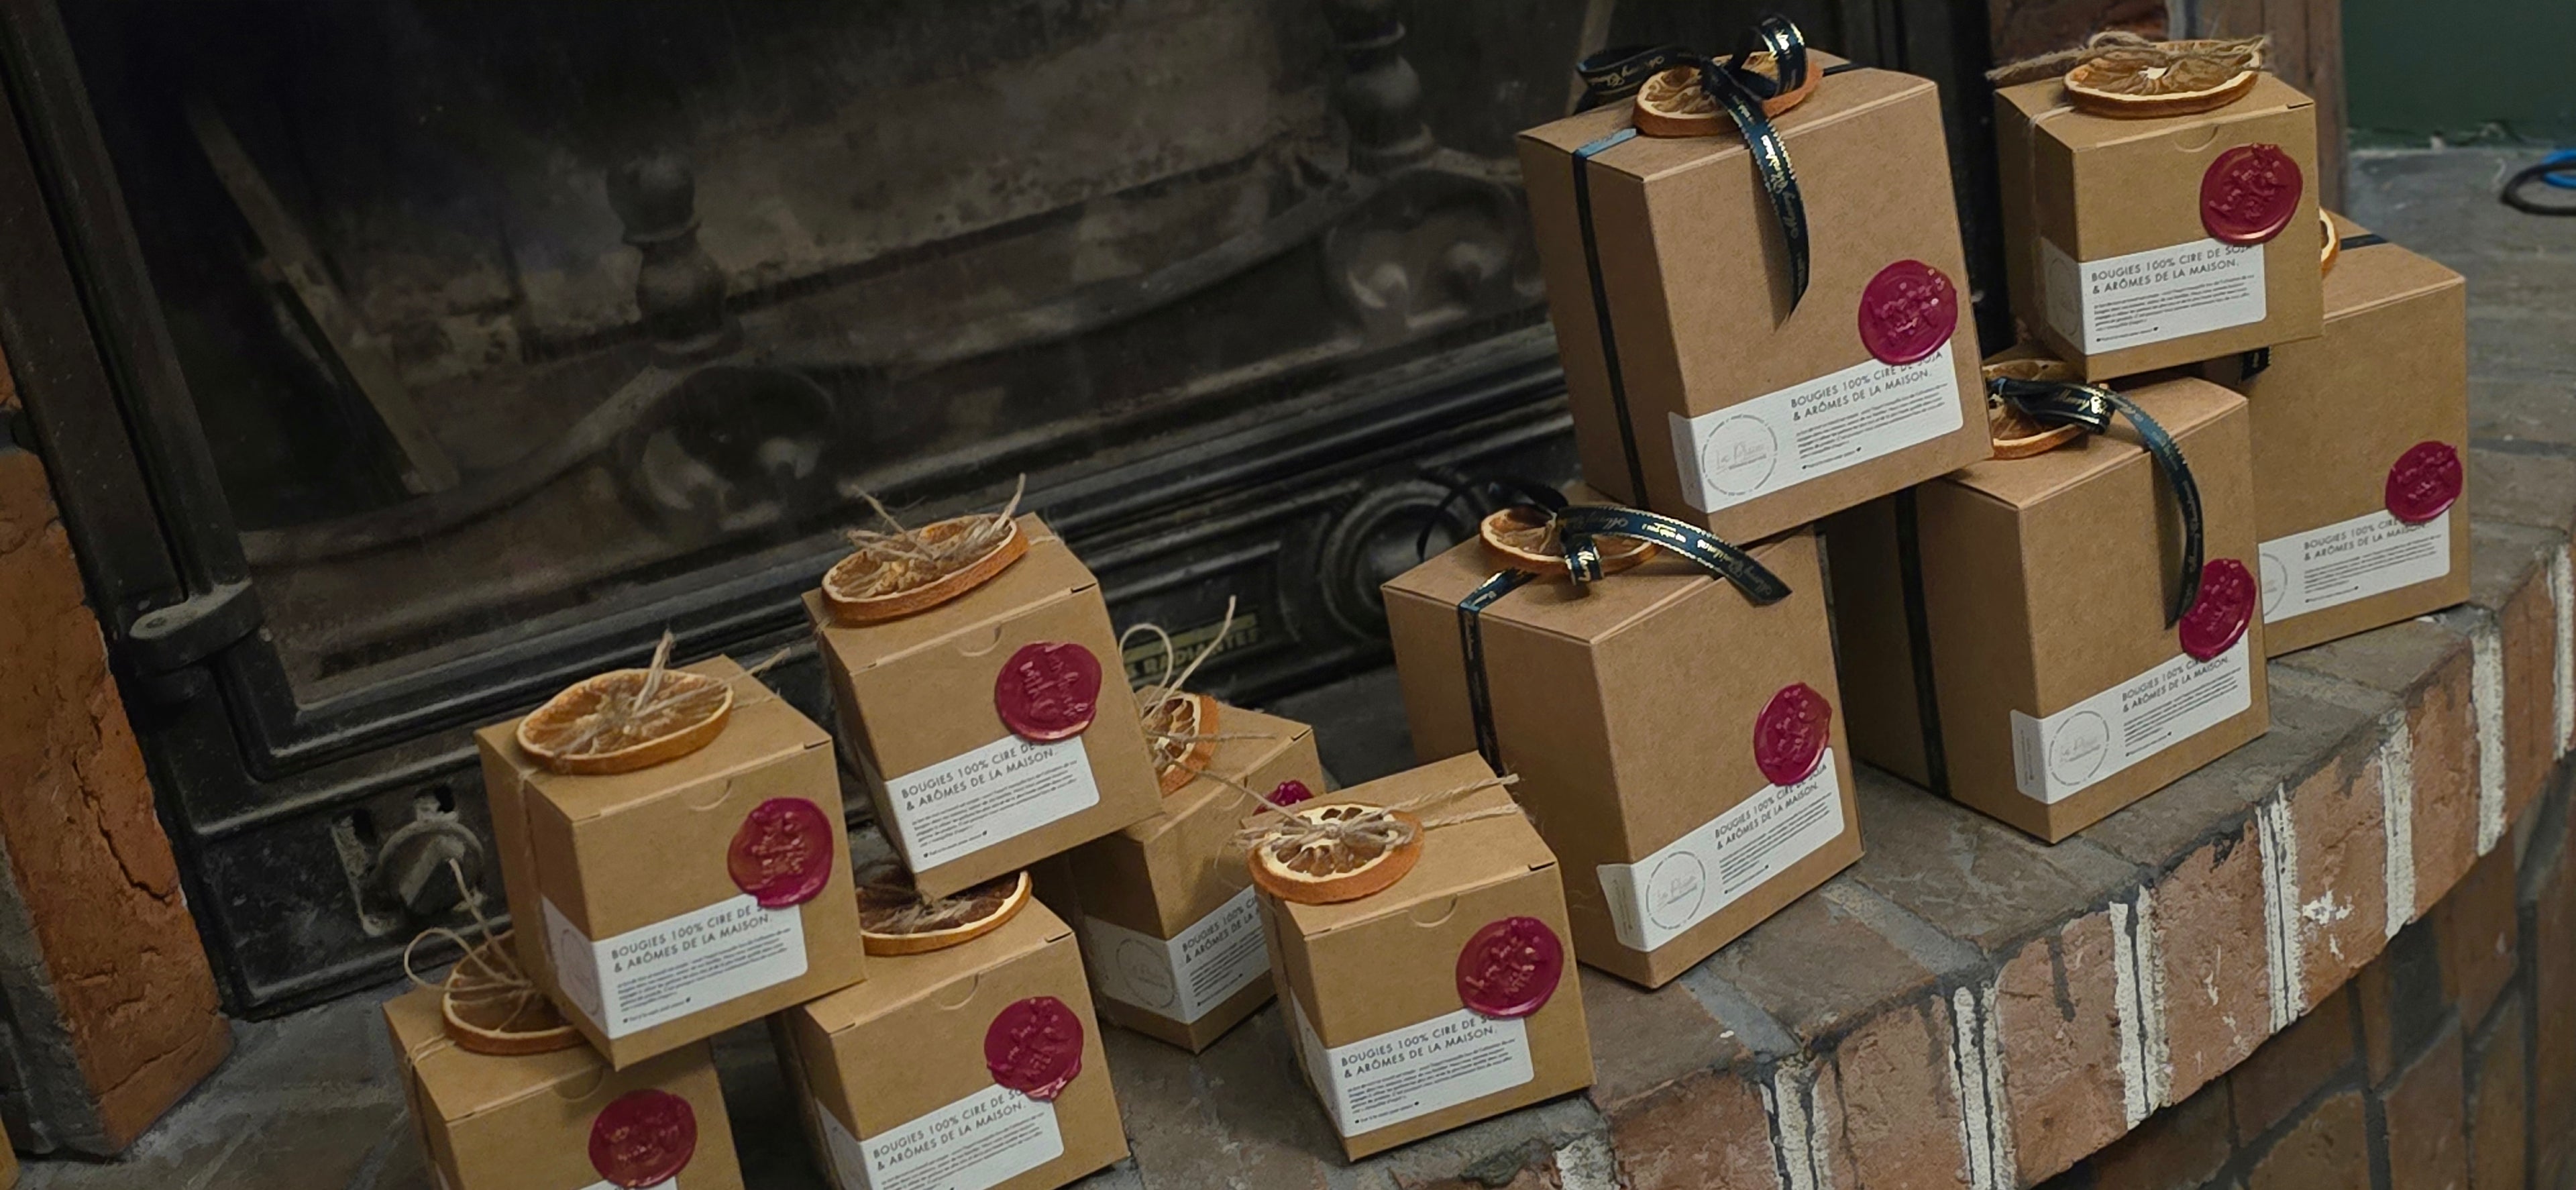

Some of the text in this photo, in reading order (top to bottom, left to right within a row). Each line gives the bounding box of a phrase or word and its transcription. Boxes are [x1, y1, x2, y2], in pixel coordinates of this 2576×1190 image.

[2092, 264, 2141, 282] BOUGIES
[2147, 258, 2176, 272] 100%
[2180, 251, 2202, 266] CIRE
[2207, 248, 2220, 259] DE
[2092, 285, 2100, 294] &
[2155, 271, 2169, 283] DE
[2173, 269, 2186, 279] LA
[1790, 384, 1837, 409] BOUGIES
[1843, 374, 1870, 391] 100%
[1874, 364, 1896, 381] CIRE
[1792, 411, 1801, 421] &
[1852, 391, 1866, 402] DE
[1870, 386, 1881, 398] LA
[901, 742, 1034, 799] BOUGIES 100% CIRE DE
[906, 801, 914, 811] &
[918, 781, 967, 807] ARÔMES
[970, 774, 985, 788] DE
[989, 767, 1003, 779] LA
[611, 934, 666, 960] BOUGIES
[672, 922, 704, 938] 100%
[707, 912, 733, 929] CIRE
[737, 906, 751, 918] DE
[614, 962, 623, 973] &
[627, 944, 679, 970] ARÔMES
[682, 938, 698, 952] DE
[702, 933, 716, 944] LA
[1341, 1045, 1393, 1067] BOUGIES
[1398, 1034, 1429, 1049] 100%
[1432, 1024, 1458, 1038] CIRE
[1462, 1018, 1476, 1030] DE
[1344, 1070, 1352, 1078] &
[1356, 1054, 1405, 1076] ARÔMES
[1409, 1048, 1425, 1059] DE
[1428, 1041, 1442, 1054] LA
[873, 1089, 1024, 1158] BOUGIES 100% CIRE DE SO
[877, 1160, 885, 1171] &
[890, 1141, 938, 1167] ARÔMES
[941, 1133, 955, 1147] DE
[959, 1125, 972, 1136] LA
